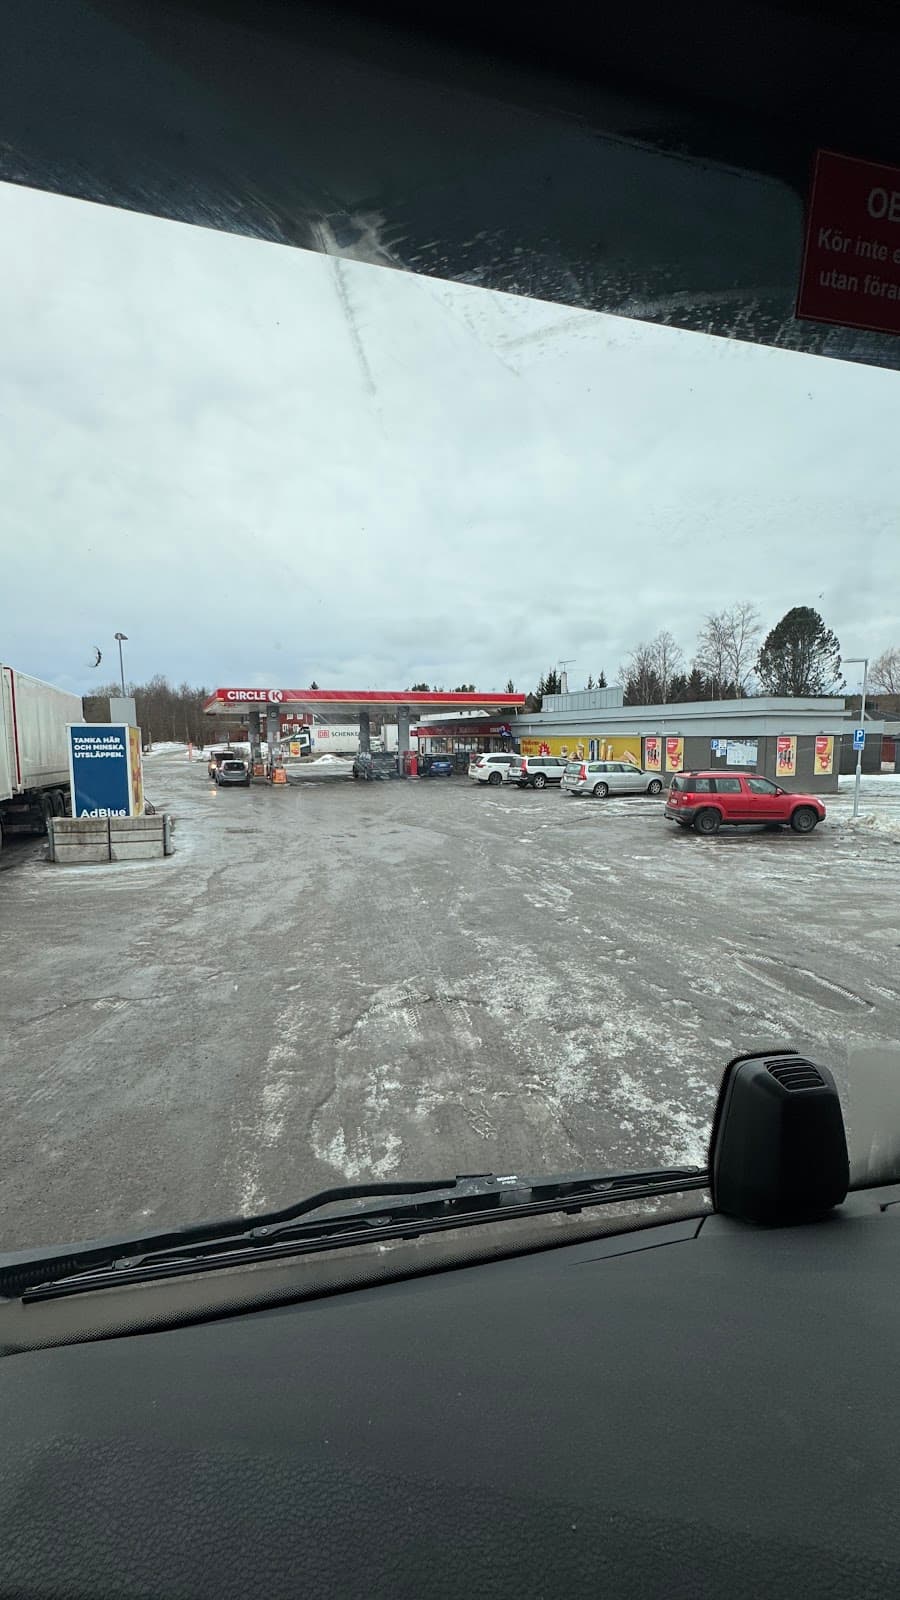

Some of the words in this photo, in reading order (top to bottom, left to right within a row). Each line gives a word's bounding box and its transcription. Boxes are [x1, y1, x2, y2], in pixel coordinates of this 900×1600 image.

[818, 226, 851, 254] Kör
[855, 235, 888, 261] inte
[820, 269, 858, 292] utan
[227, 691, 266, 700] CIRCLE
[268, 689, 283, 703] K
[80, 808, 126, 818] AdBlue
